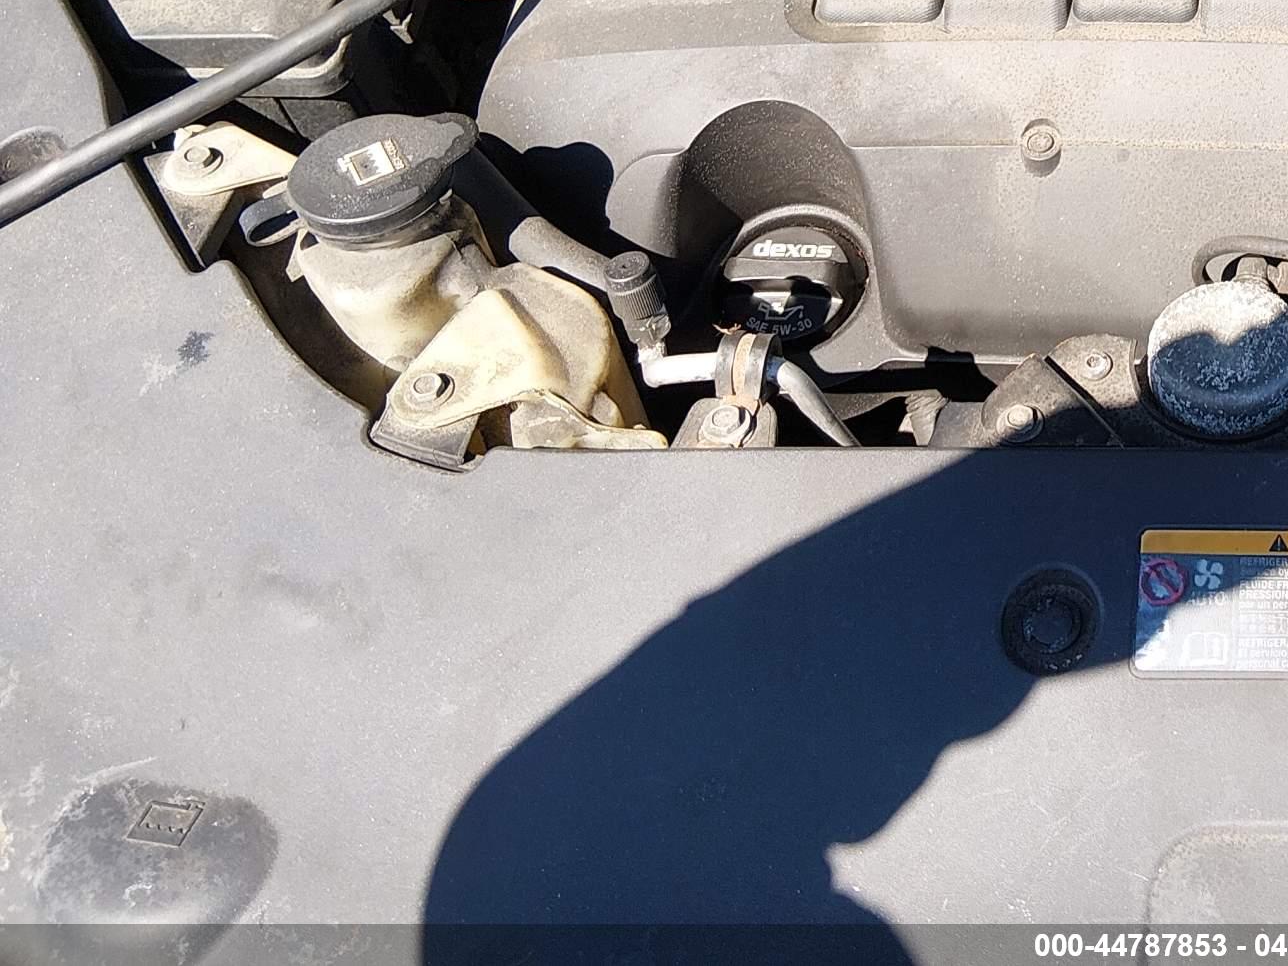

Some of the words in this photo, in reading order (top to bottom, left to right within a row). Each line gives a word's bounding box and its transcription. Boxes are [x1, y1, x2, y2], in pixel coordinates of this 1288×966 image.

[753, 239, 835, 258] dexos
[746, 317, 769, 333] SAE
[772, 318, 813, 335] 5W-30
[1240, 580, 1274, 590] FLUIDE
